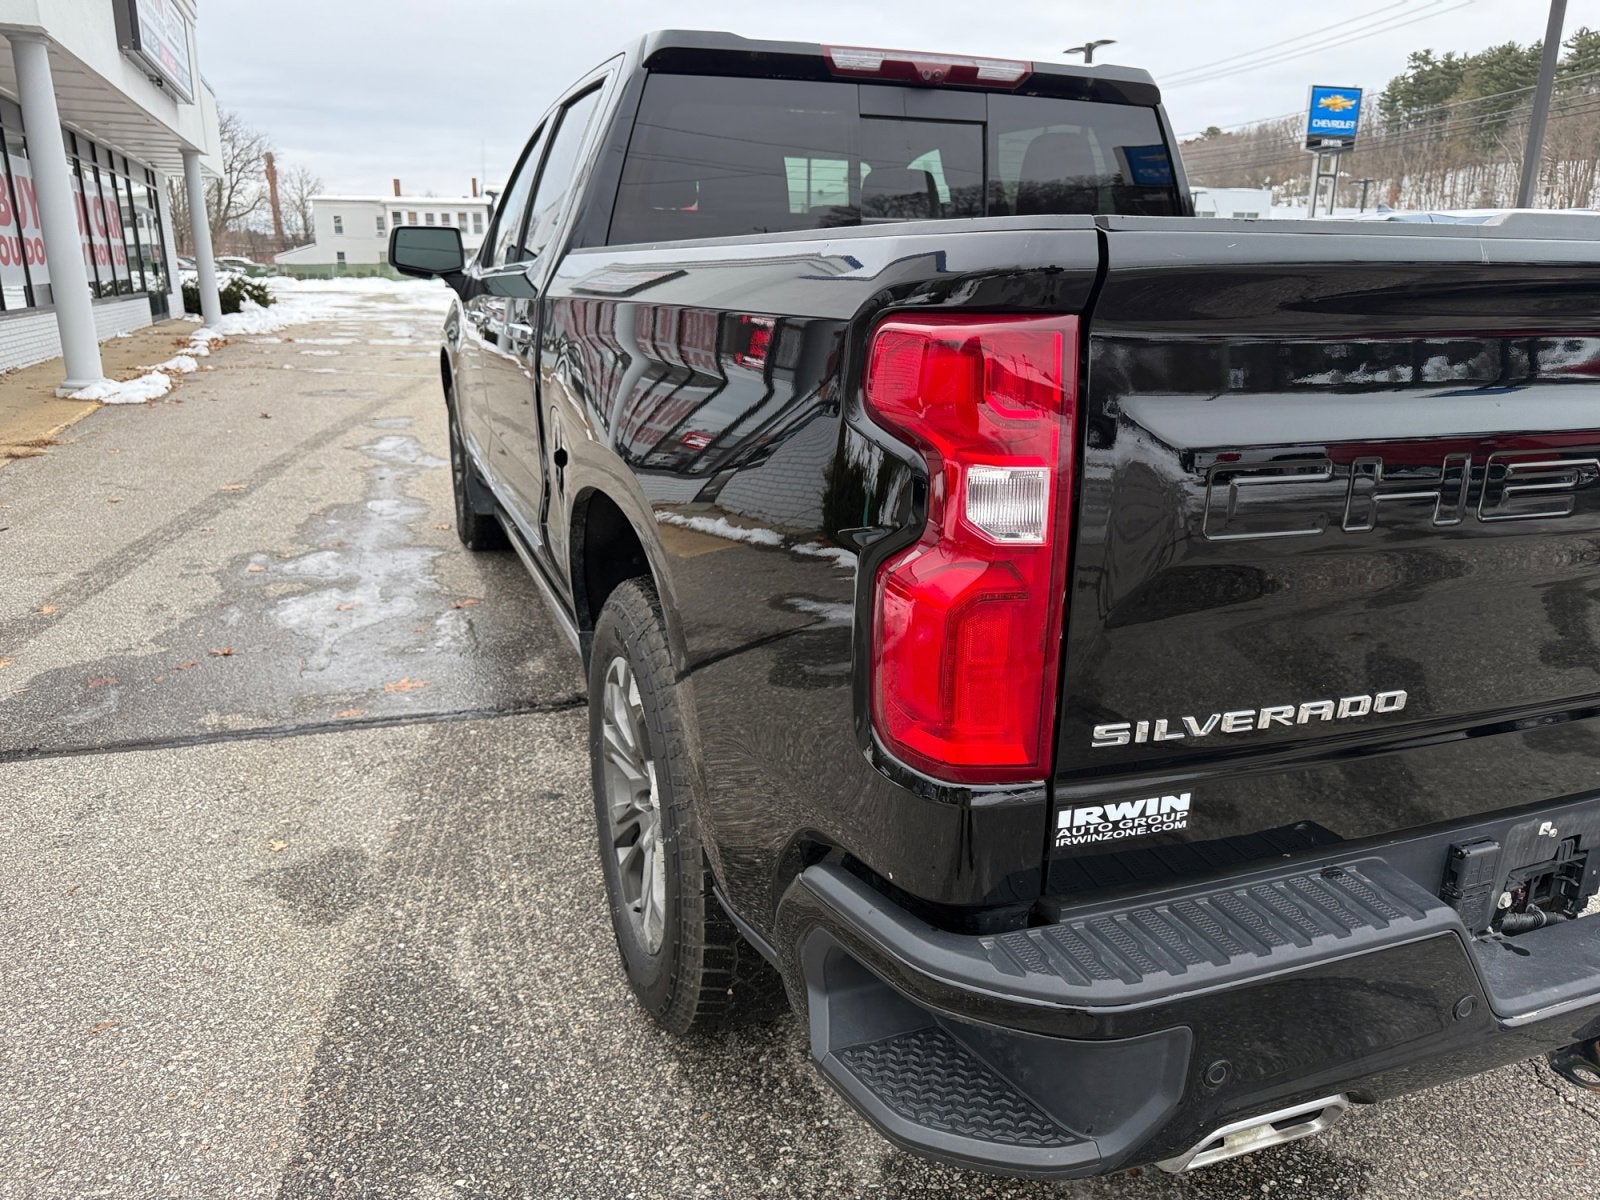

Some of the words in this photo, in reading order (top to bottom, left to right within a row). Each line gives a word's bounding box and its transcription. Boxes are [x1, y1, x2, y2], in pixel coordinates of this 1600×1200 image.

[1312, 119, 1356, 129] CHEVROLET
[1091, 689, 1408, 748] SILVERADO
[1056, 822, 1113, 838] AUTO
[1118, 810, 1189, 829] GROUP
[1057, 792, 1192, 829] IRWIN
[1055, 820, 1187, 848] IRWINZONE.COM
